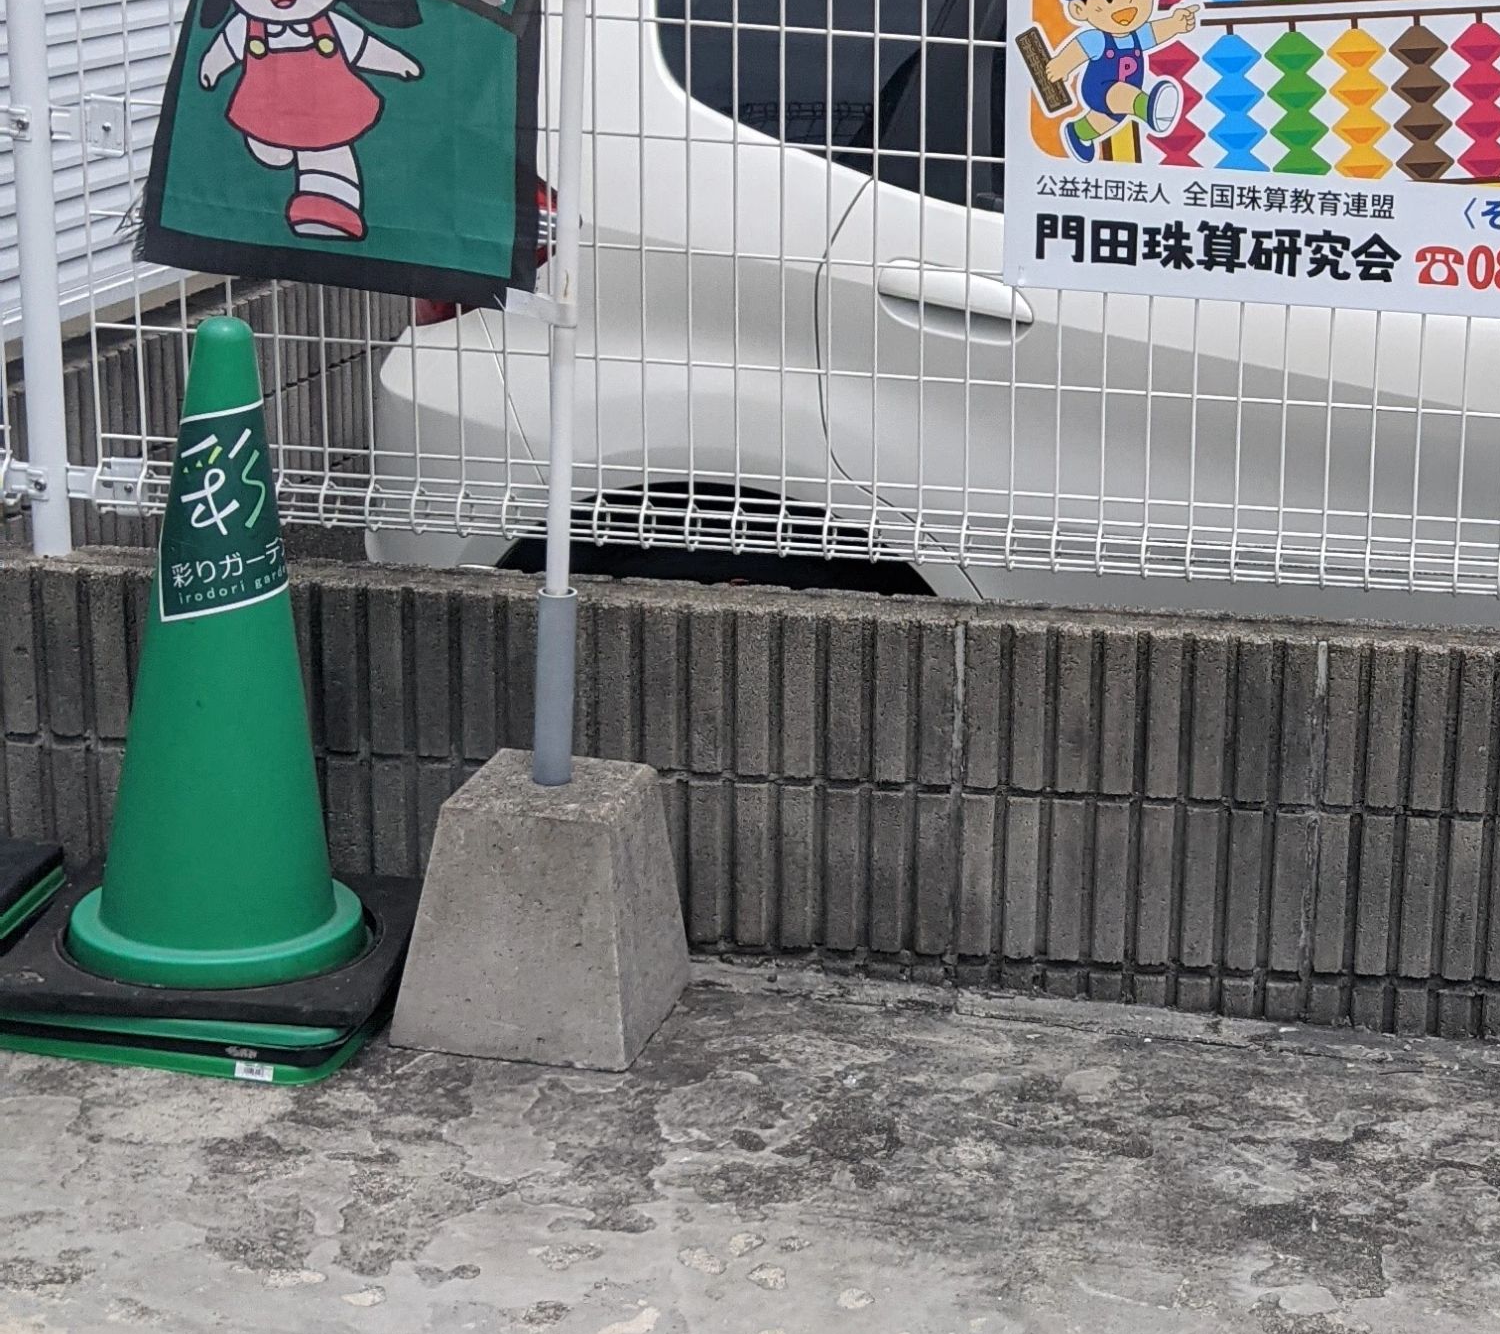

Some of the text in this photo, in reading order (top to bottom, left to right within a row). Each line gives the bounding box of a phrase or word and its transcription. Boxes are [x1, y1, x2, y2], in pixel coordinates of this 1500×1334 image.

[1036, 174, 1396, 220] 公益社団法人 全国珠算教育連盟
[1035, 212, 1403, 283] 門田珠算研究会
[177, 580, 245, 605] irodori
